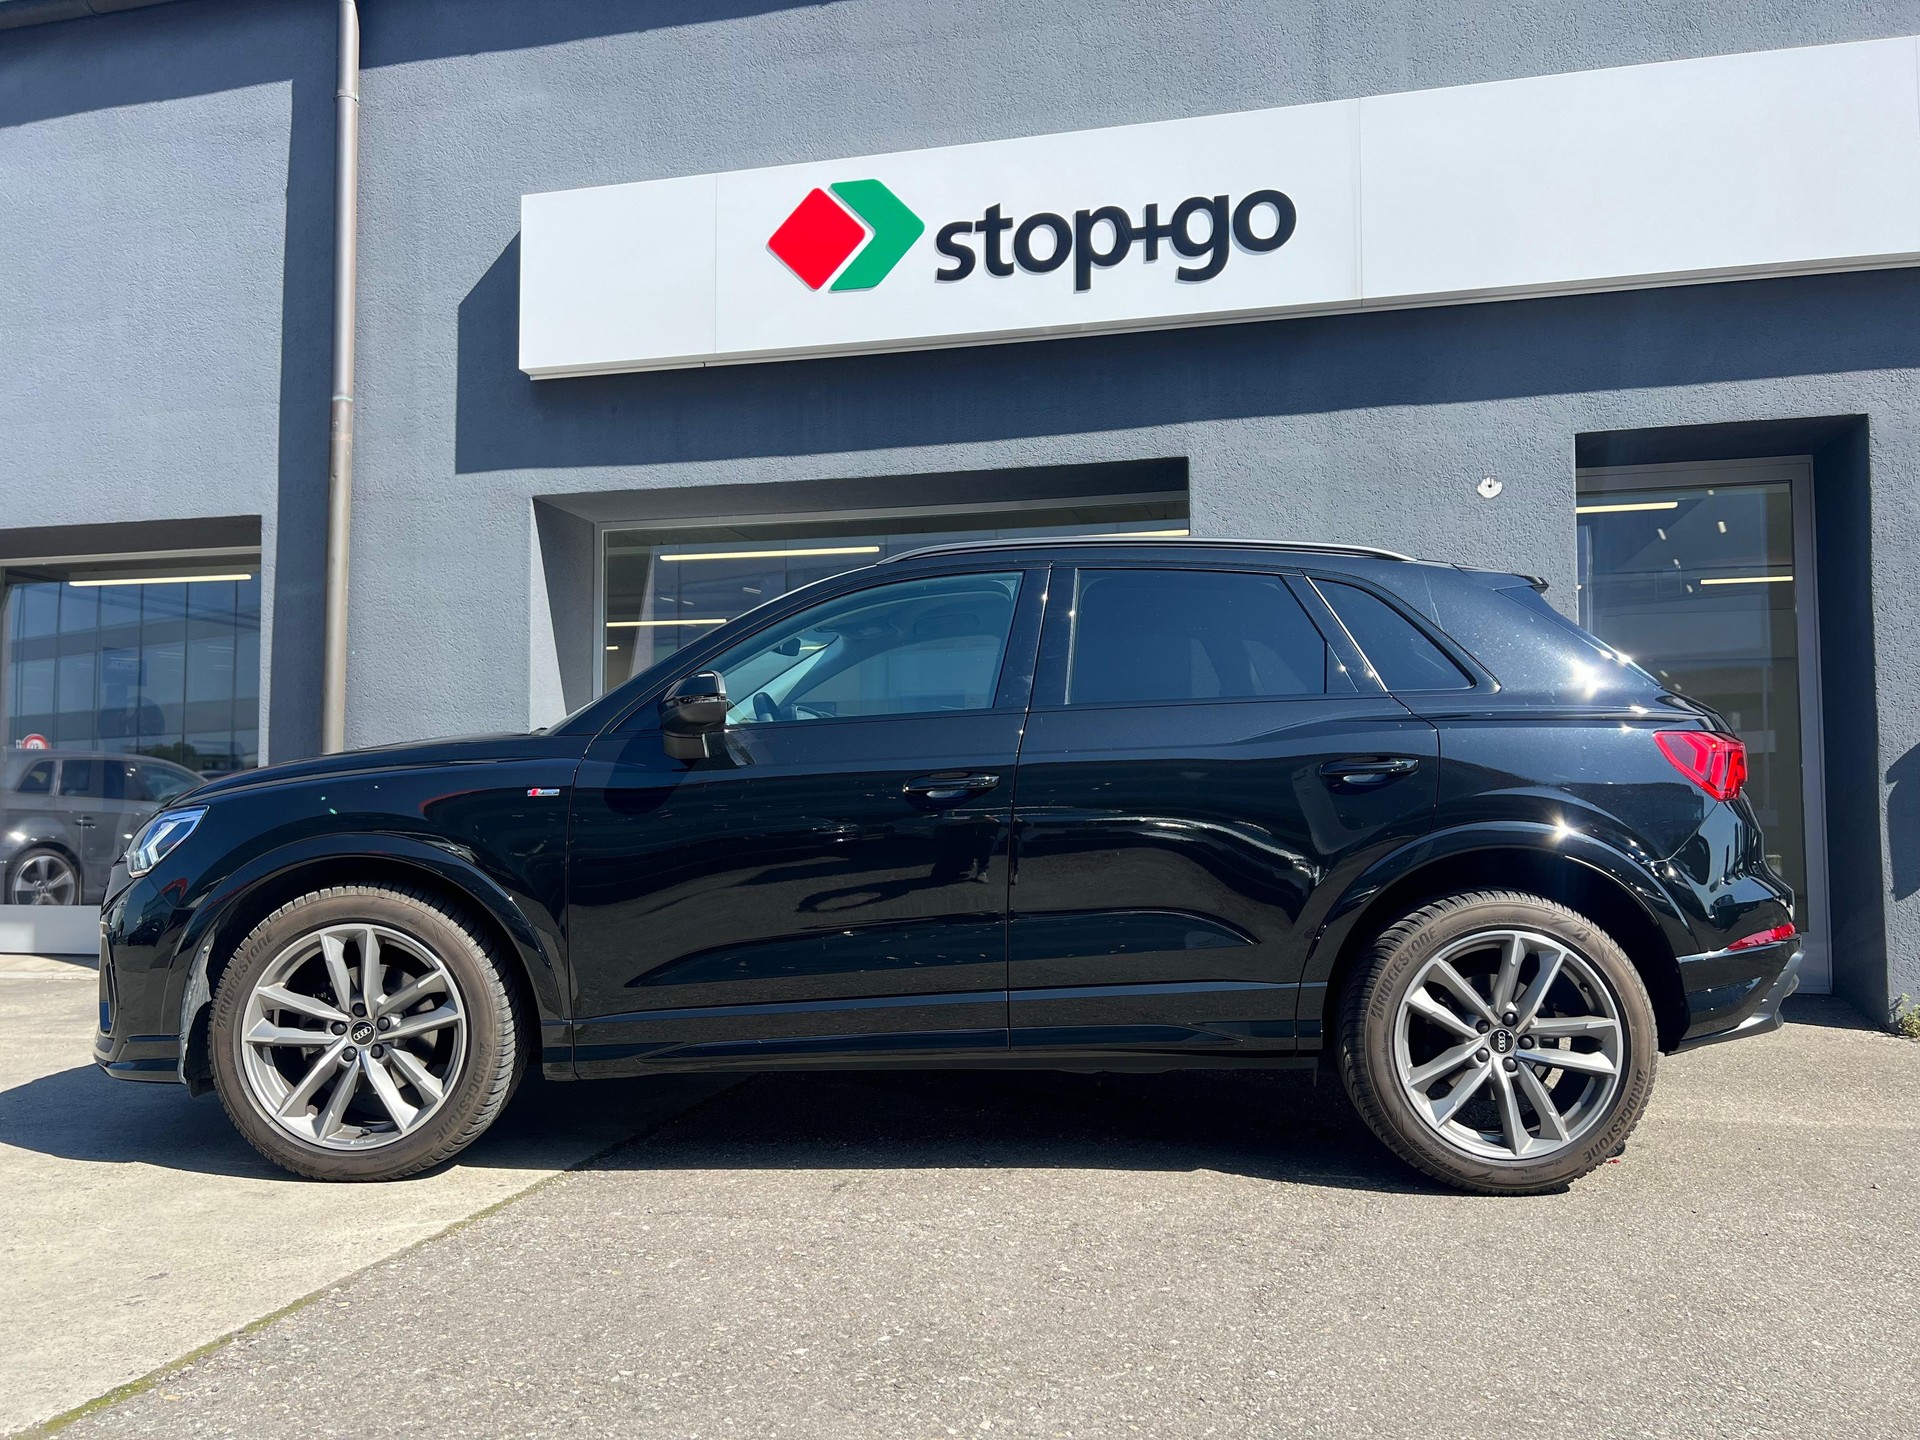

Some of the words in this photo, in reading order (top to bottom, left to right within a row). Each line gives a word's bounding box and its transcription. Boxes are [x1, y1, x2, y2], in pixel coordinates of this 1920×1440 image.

[936, 189, 1297, 292] stop+go
[216, 931, 275, 1030] BRIDGESTONE
[1370, 926, 1438, 1021] BRIDGESTONE
[433, 1042, 492, 1143] BRIDGESTONE
[1582, 1068, 1648, 1163] BRIDGESTONE
